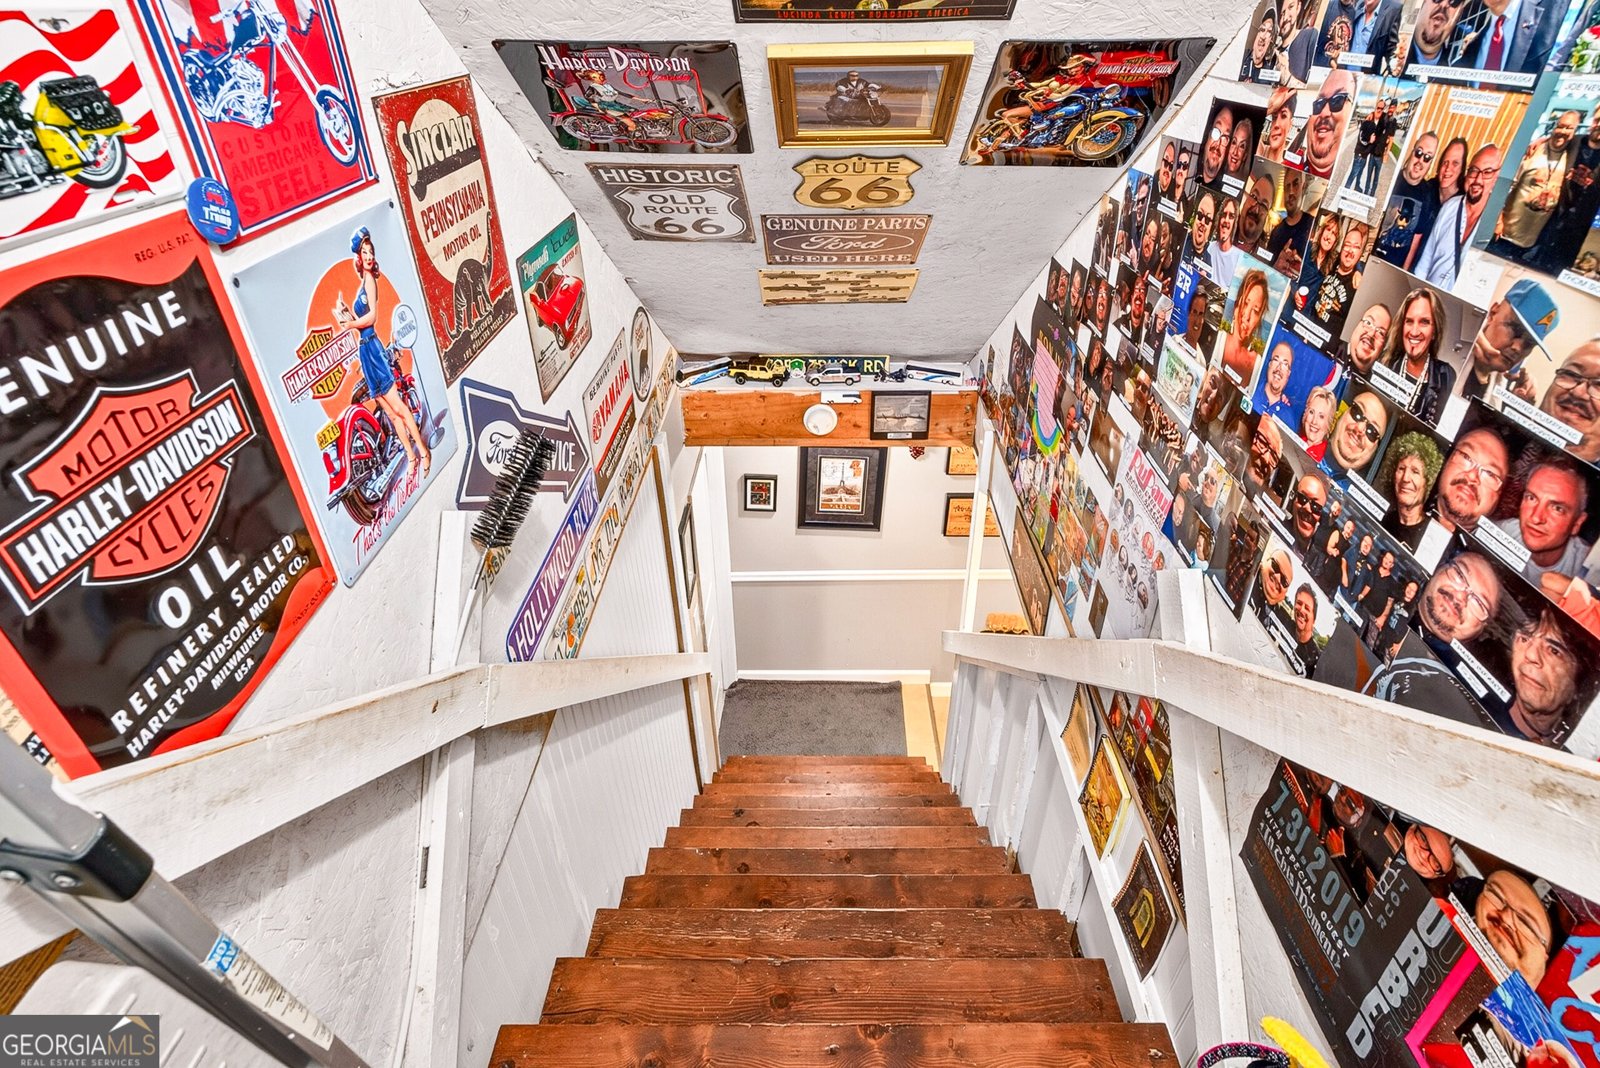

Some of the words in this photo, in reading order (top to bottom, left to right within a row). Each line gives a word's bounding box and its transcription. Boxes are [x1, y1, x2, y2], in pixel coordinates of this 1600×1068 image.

[777, 10, 821, 20] LUCINDA
[828, 10, 856, 20] LEWIS
[868, 9, 920, 20] ROADSIDE
[926, 8, 970, 18] AMERICA
[397, 115, 476, 188] SINCLAIR
[598, 168, 734, 183] HISTORIC
[815, 161, 900, 174] ROUTE
[238, 164, 322, 218] STEEL
[421, 179, 485, 243] PENNSYLVANIA
[643, 206, 719, 215] ROUTE
[647, 194, 706, 205] OLD
[809, 176, 900, 205] 66
[442, 234, 469, 262] MOTOR
[470, 229, 482, 247] OIL
[653, 216, 725, 235] 66
[766, 216, 857, 231] GENUINE
[863, 216, 927, 231] PARTS
[801, 234, 888, 251] Ford
[774, 254, 839, 263] USED
[844, 253, 912, 263] HERE
[0, 290, 187, 415] ENUINE
[863, 359, 884, 373] RD
[589, 368, 610, 401] GENUINE
[599, 360, 630, 427] YAMAHA
[61, 398, 181, 486] MOTOR
[16, 397, 243, 585] HARLEY-DAVIDSON
[107, 473, 215, 568] CYCLES
[158, 545, 241, 630] OIL
[515, 523, 576, 658] HOLLYWOOD
[573, 486, 594, 542] BLVD
[111, 608, 225, 735] REFINERY
[234, 534, 296, 608] SEALED
[126, 616, 250, 758] HARLEY-DAVIDSON
[249, 570, 288, 620] MOTOR
[288, 556, 309, 577] CO.
[210, 625, 266, 691] MILWAUKEE
[234, 659, 255, 683] USA
[1264, 807, 1283, 841] WITH
[1284, 845, 1317, 904] SPECIAL
[1320, 910, 1350, 958] GUEST
[1270, 780, 1365, 948] 7.31.2019
